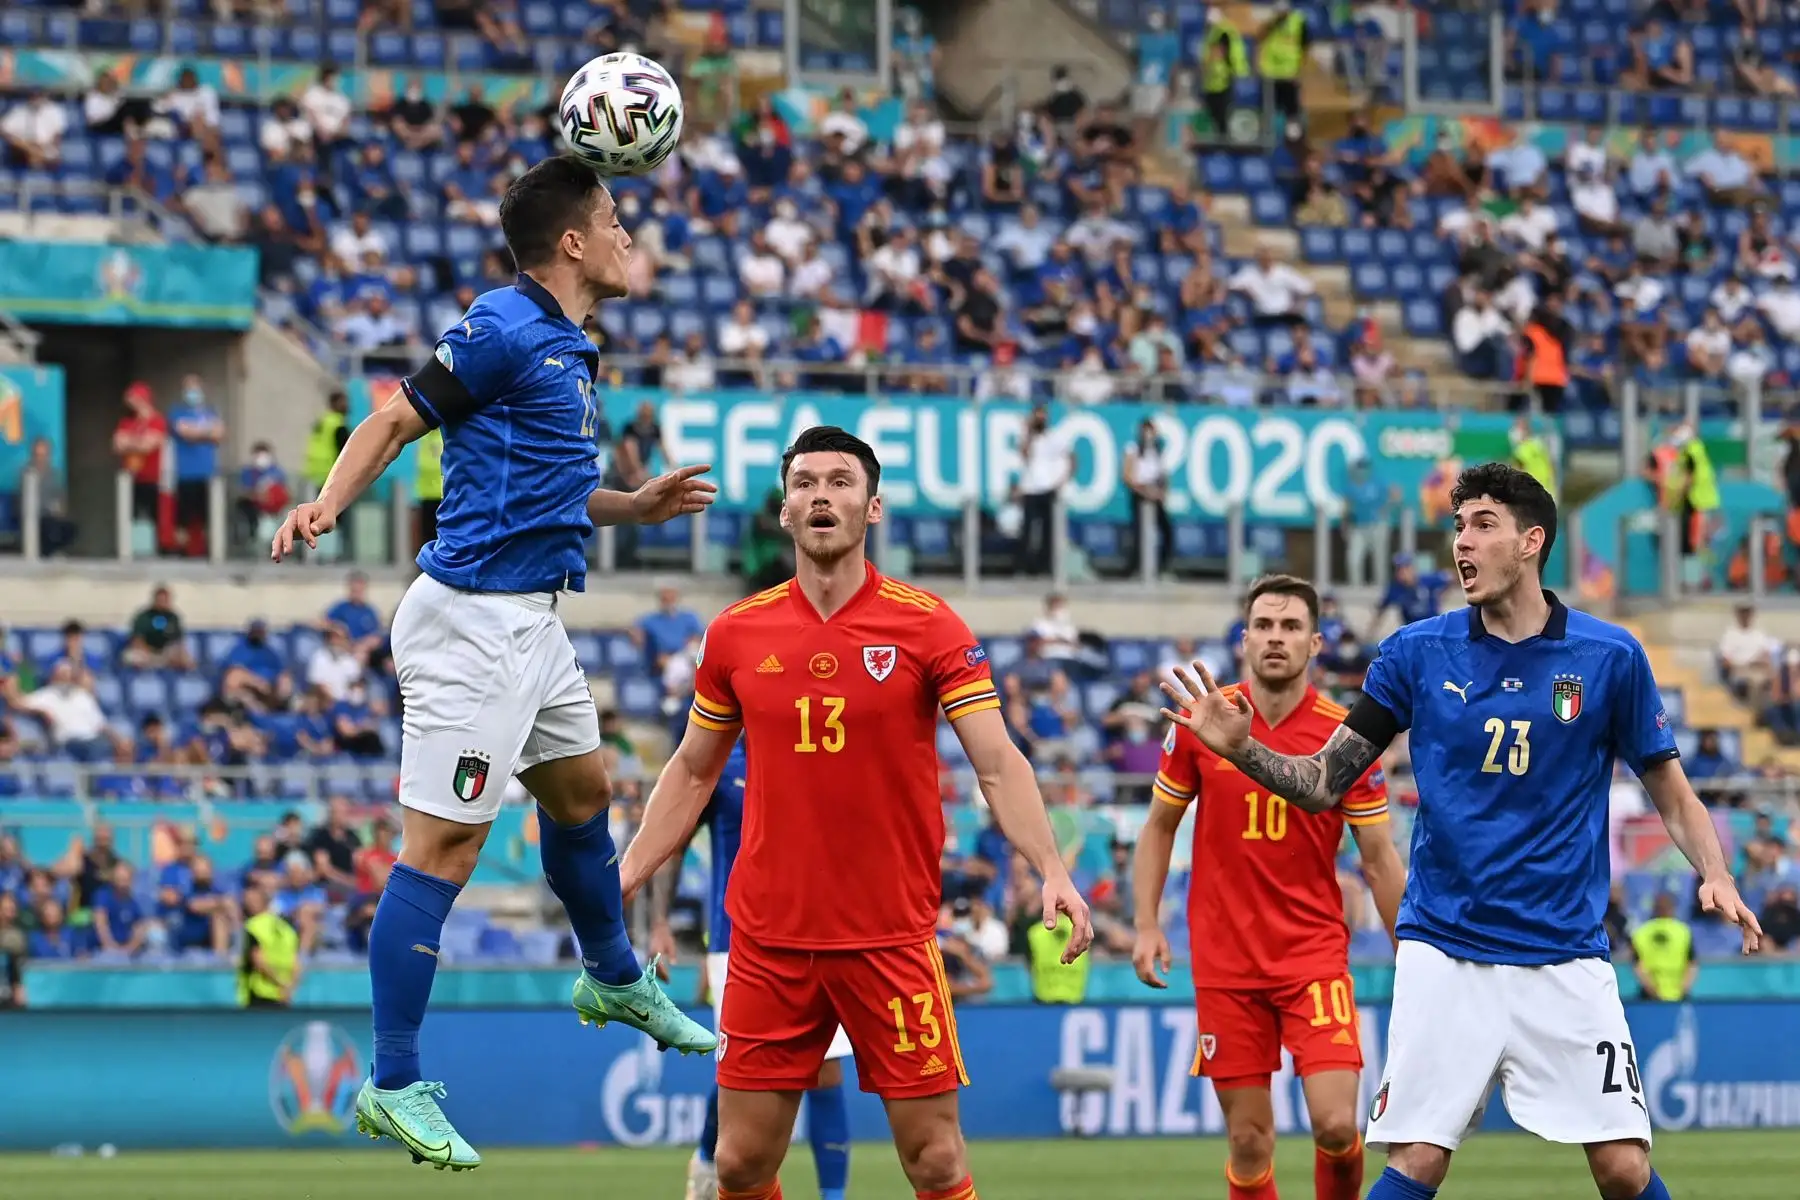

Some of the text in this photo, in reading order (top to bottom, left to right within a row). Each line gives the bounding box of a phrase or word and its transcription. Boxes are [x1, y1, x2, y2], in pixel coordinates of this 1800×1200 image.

[1555, 683, 1580, 692] ITALIA
[794, 696, 845, 753] 13
[1481, 717, 1532, 776] 23
[1241, 791, 1287, 841] 10
[888, 992, 941, 1053] 13
[1307, 980, 1351, 1027] 10
[1596, 1041, 1640, 1094] 23
